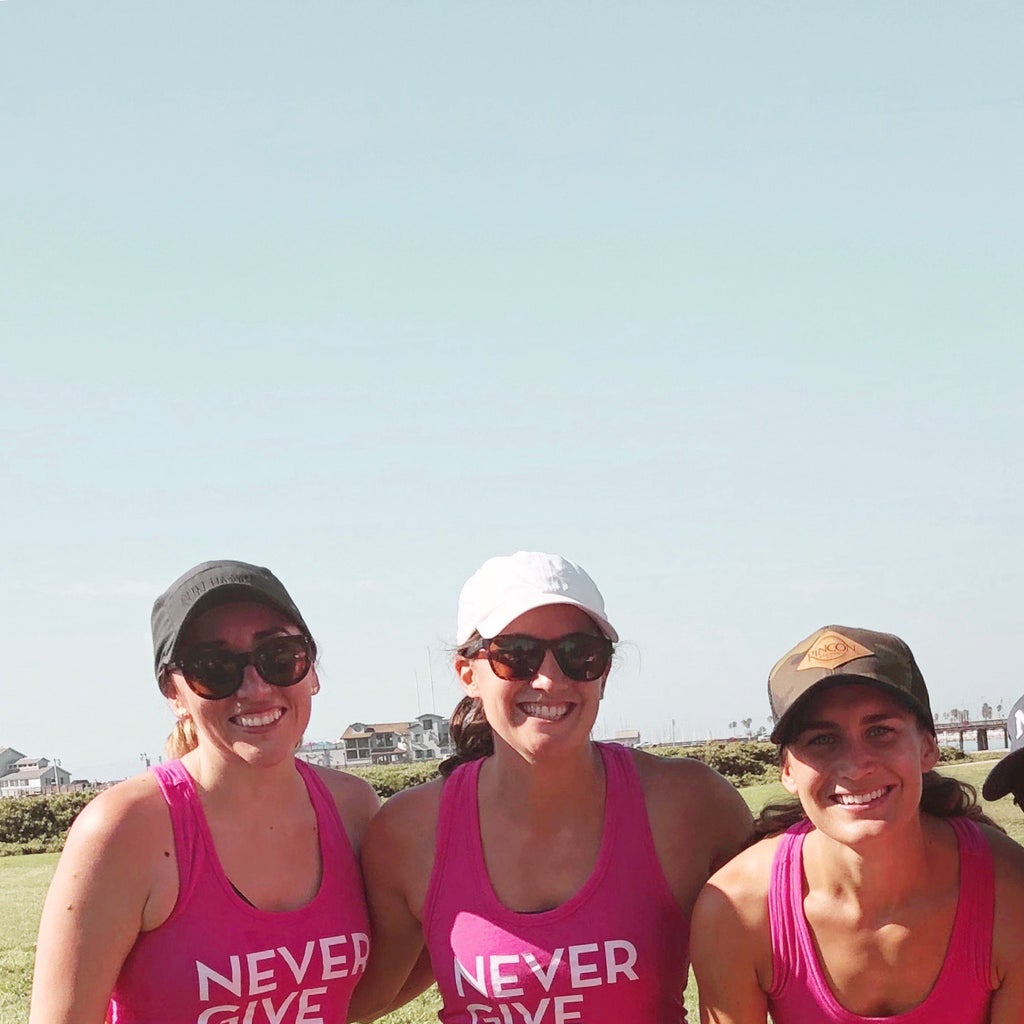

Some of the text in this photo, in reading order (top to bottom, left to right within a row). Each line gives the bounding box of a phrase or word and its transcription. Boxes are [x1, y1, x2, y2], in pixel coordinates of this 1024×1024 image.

[808, 642, 856, 662] RINCON
[195, 932, 370, 1002] NEVER
[453, 939, 640, 999] NEVER
